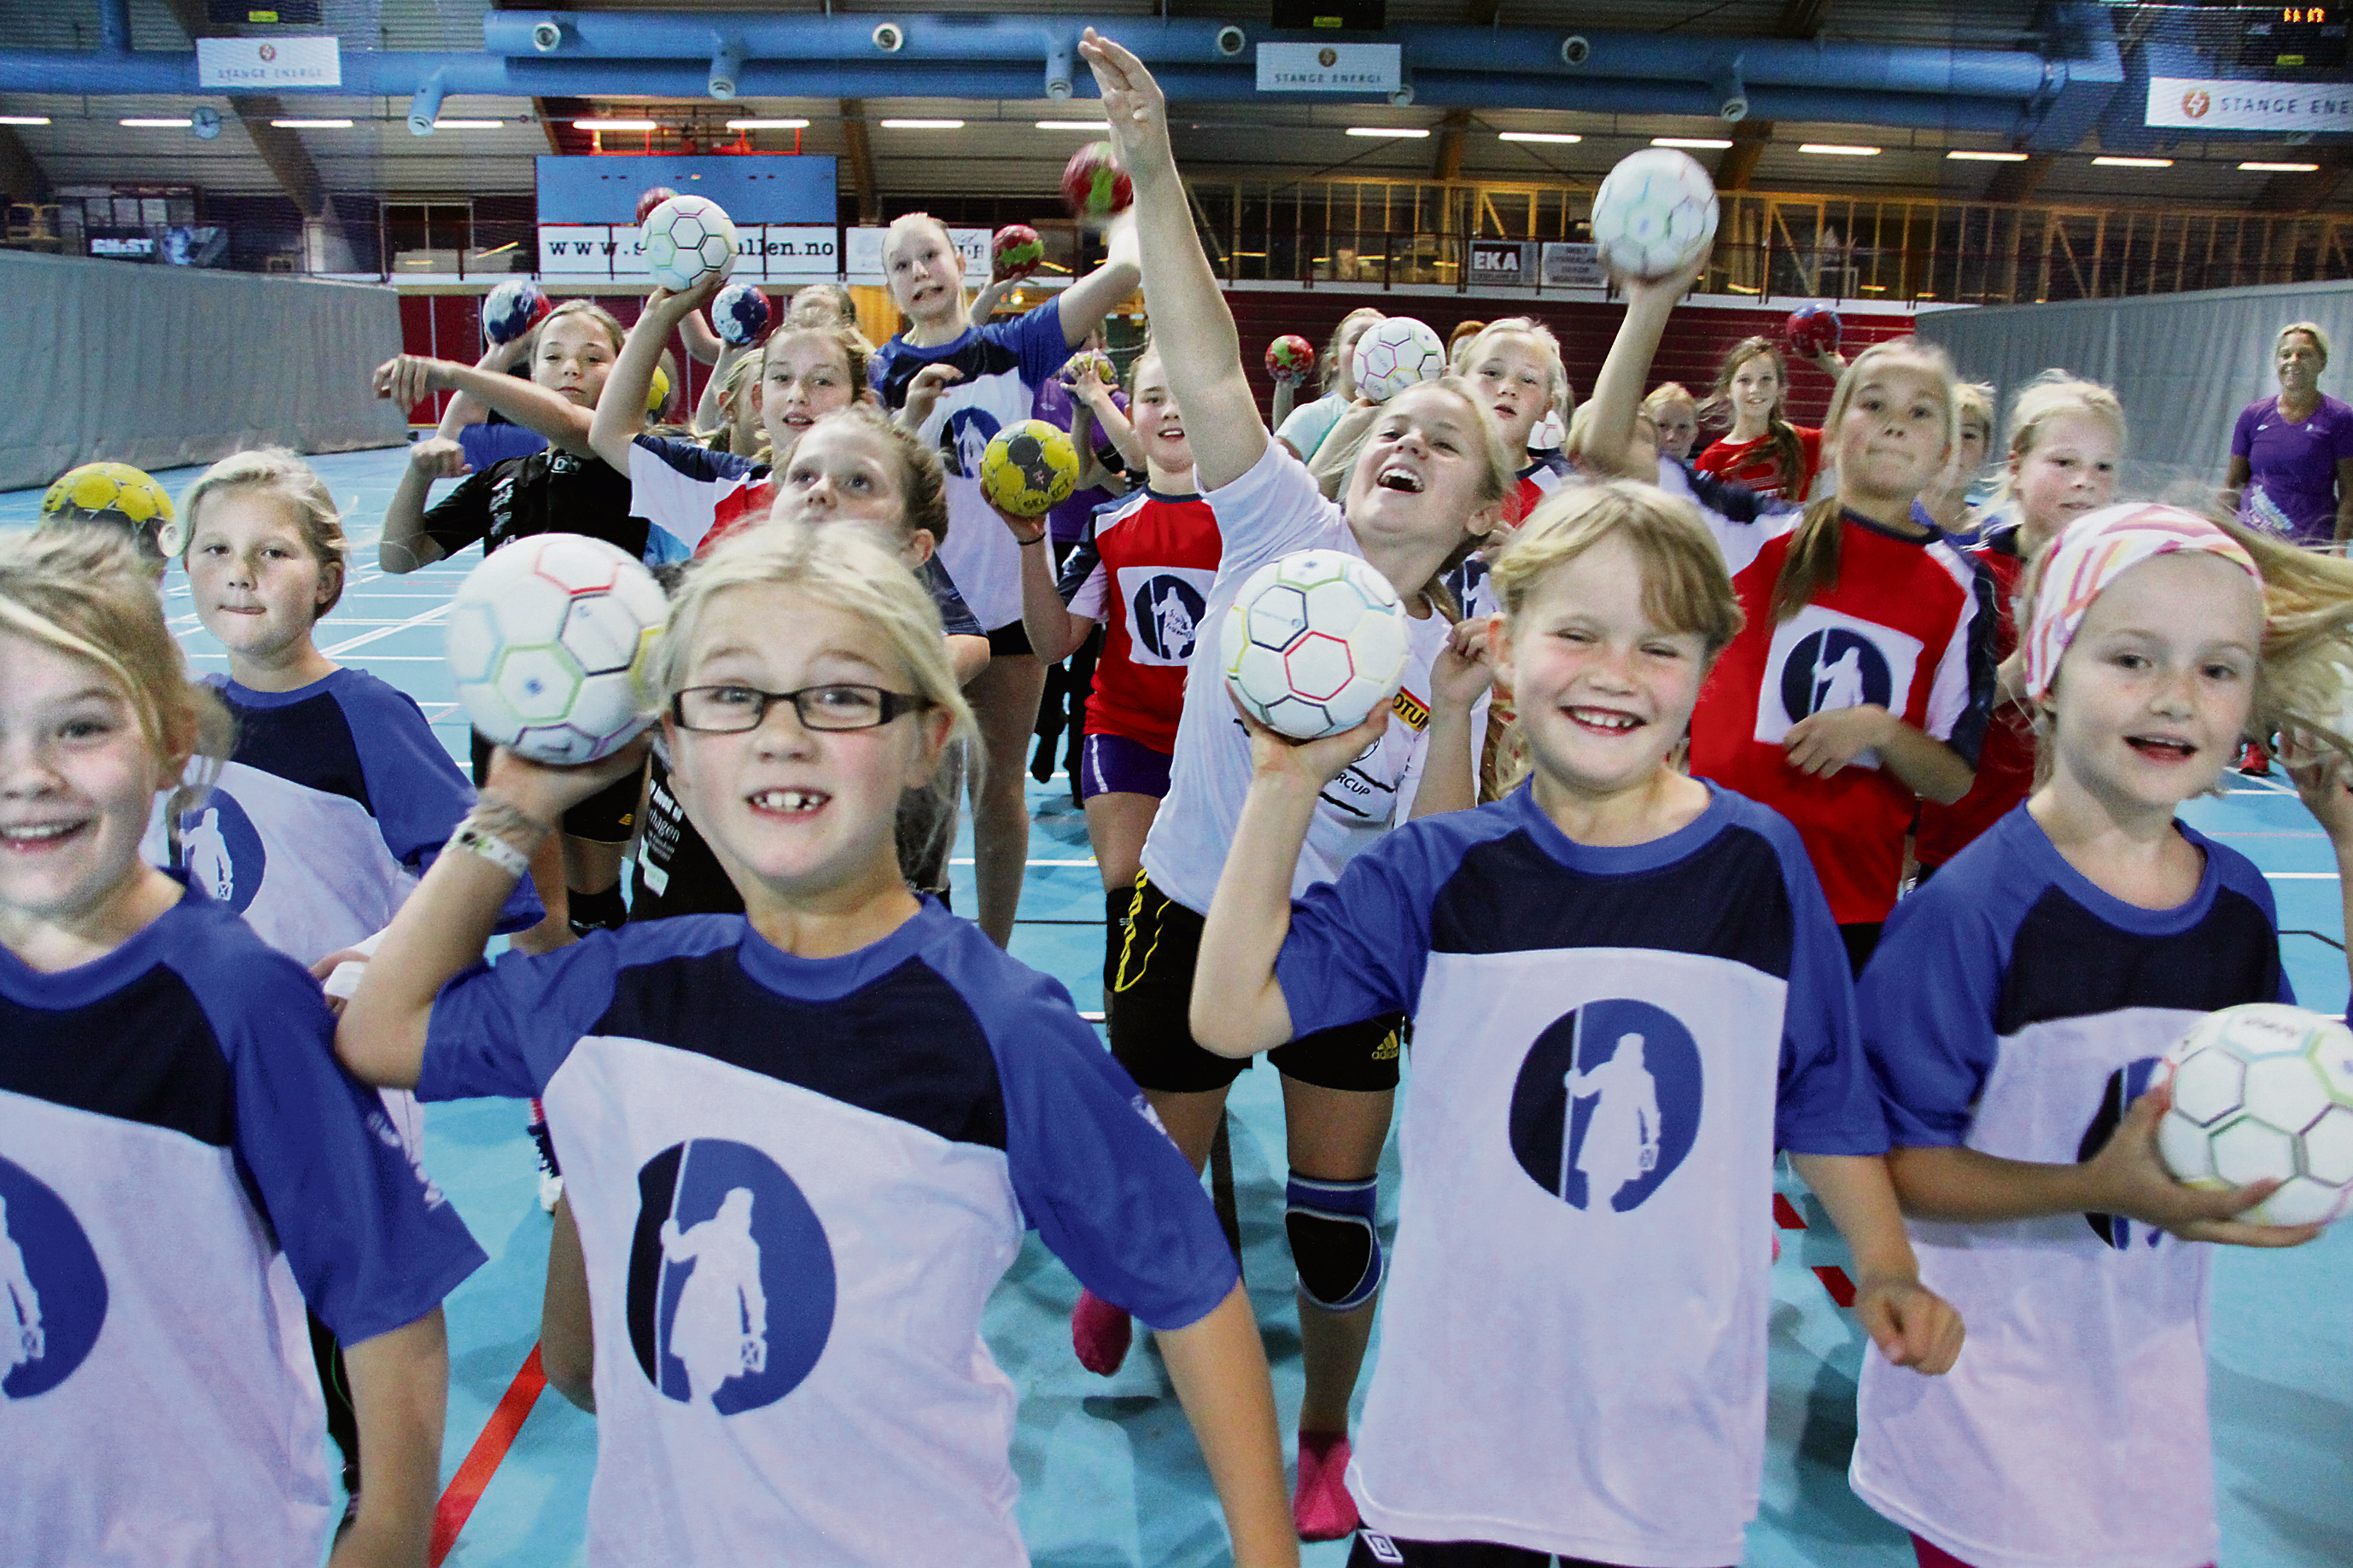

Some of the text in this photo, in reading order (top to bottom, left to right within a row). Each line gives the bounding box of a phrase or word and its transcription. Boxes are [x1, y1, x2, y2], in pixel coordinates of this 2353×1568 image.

[218, 68, 266, 79] STANGE
[1275, 73, 1381, 83] STANGE ENERGI
[2221, 97, 2298, 114] STANGE
[1474, 251, 1519, 271] EKA
